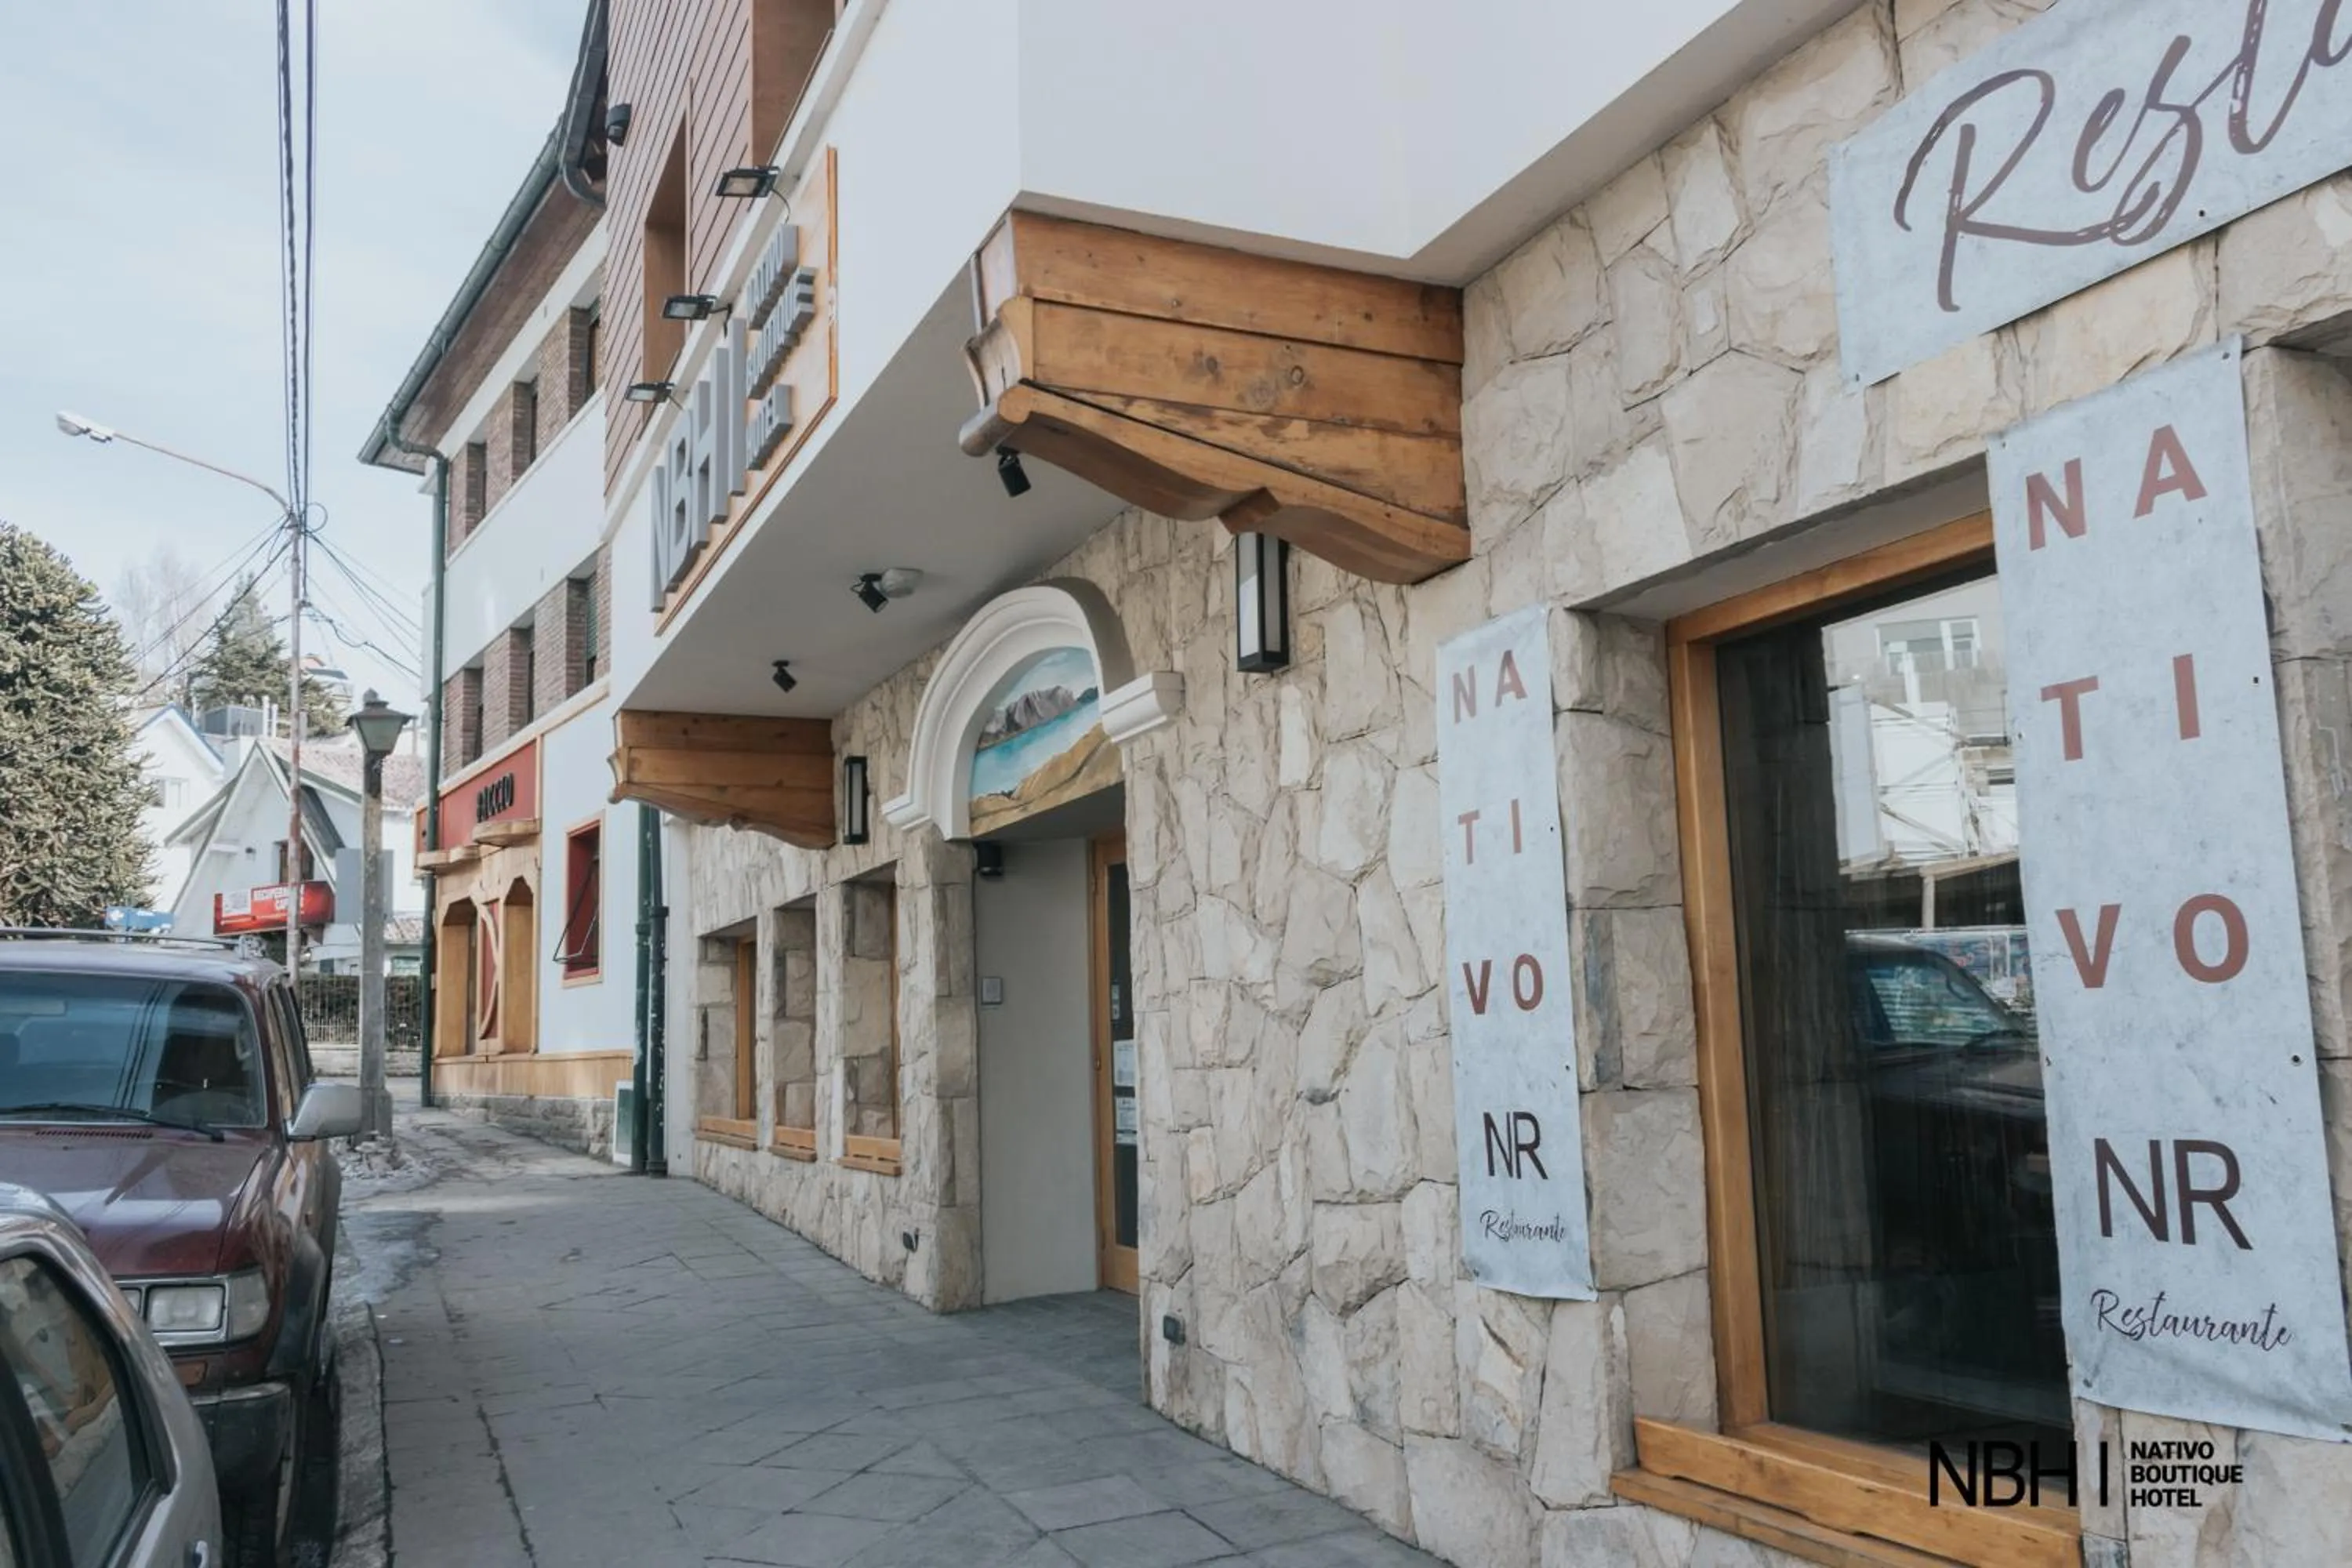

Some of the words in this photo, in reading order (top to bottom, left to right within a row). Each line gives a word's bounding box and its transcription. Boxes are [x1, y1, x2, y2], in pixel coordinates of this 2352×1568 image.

[652, 346, 728, 613] NBH
[1483, 1112, 1548, 1180] NR
[1479, 1208, 1567, 1243] Restaurante
[2093, 1138, 2253, 1250] NR
[2090, 1288, 2293, 1352] Restaurante
